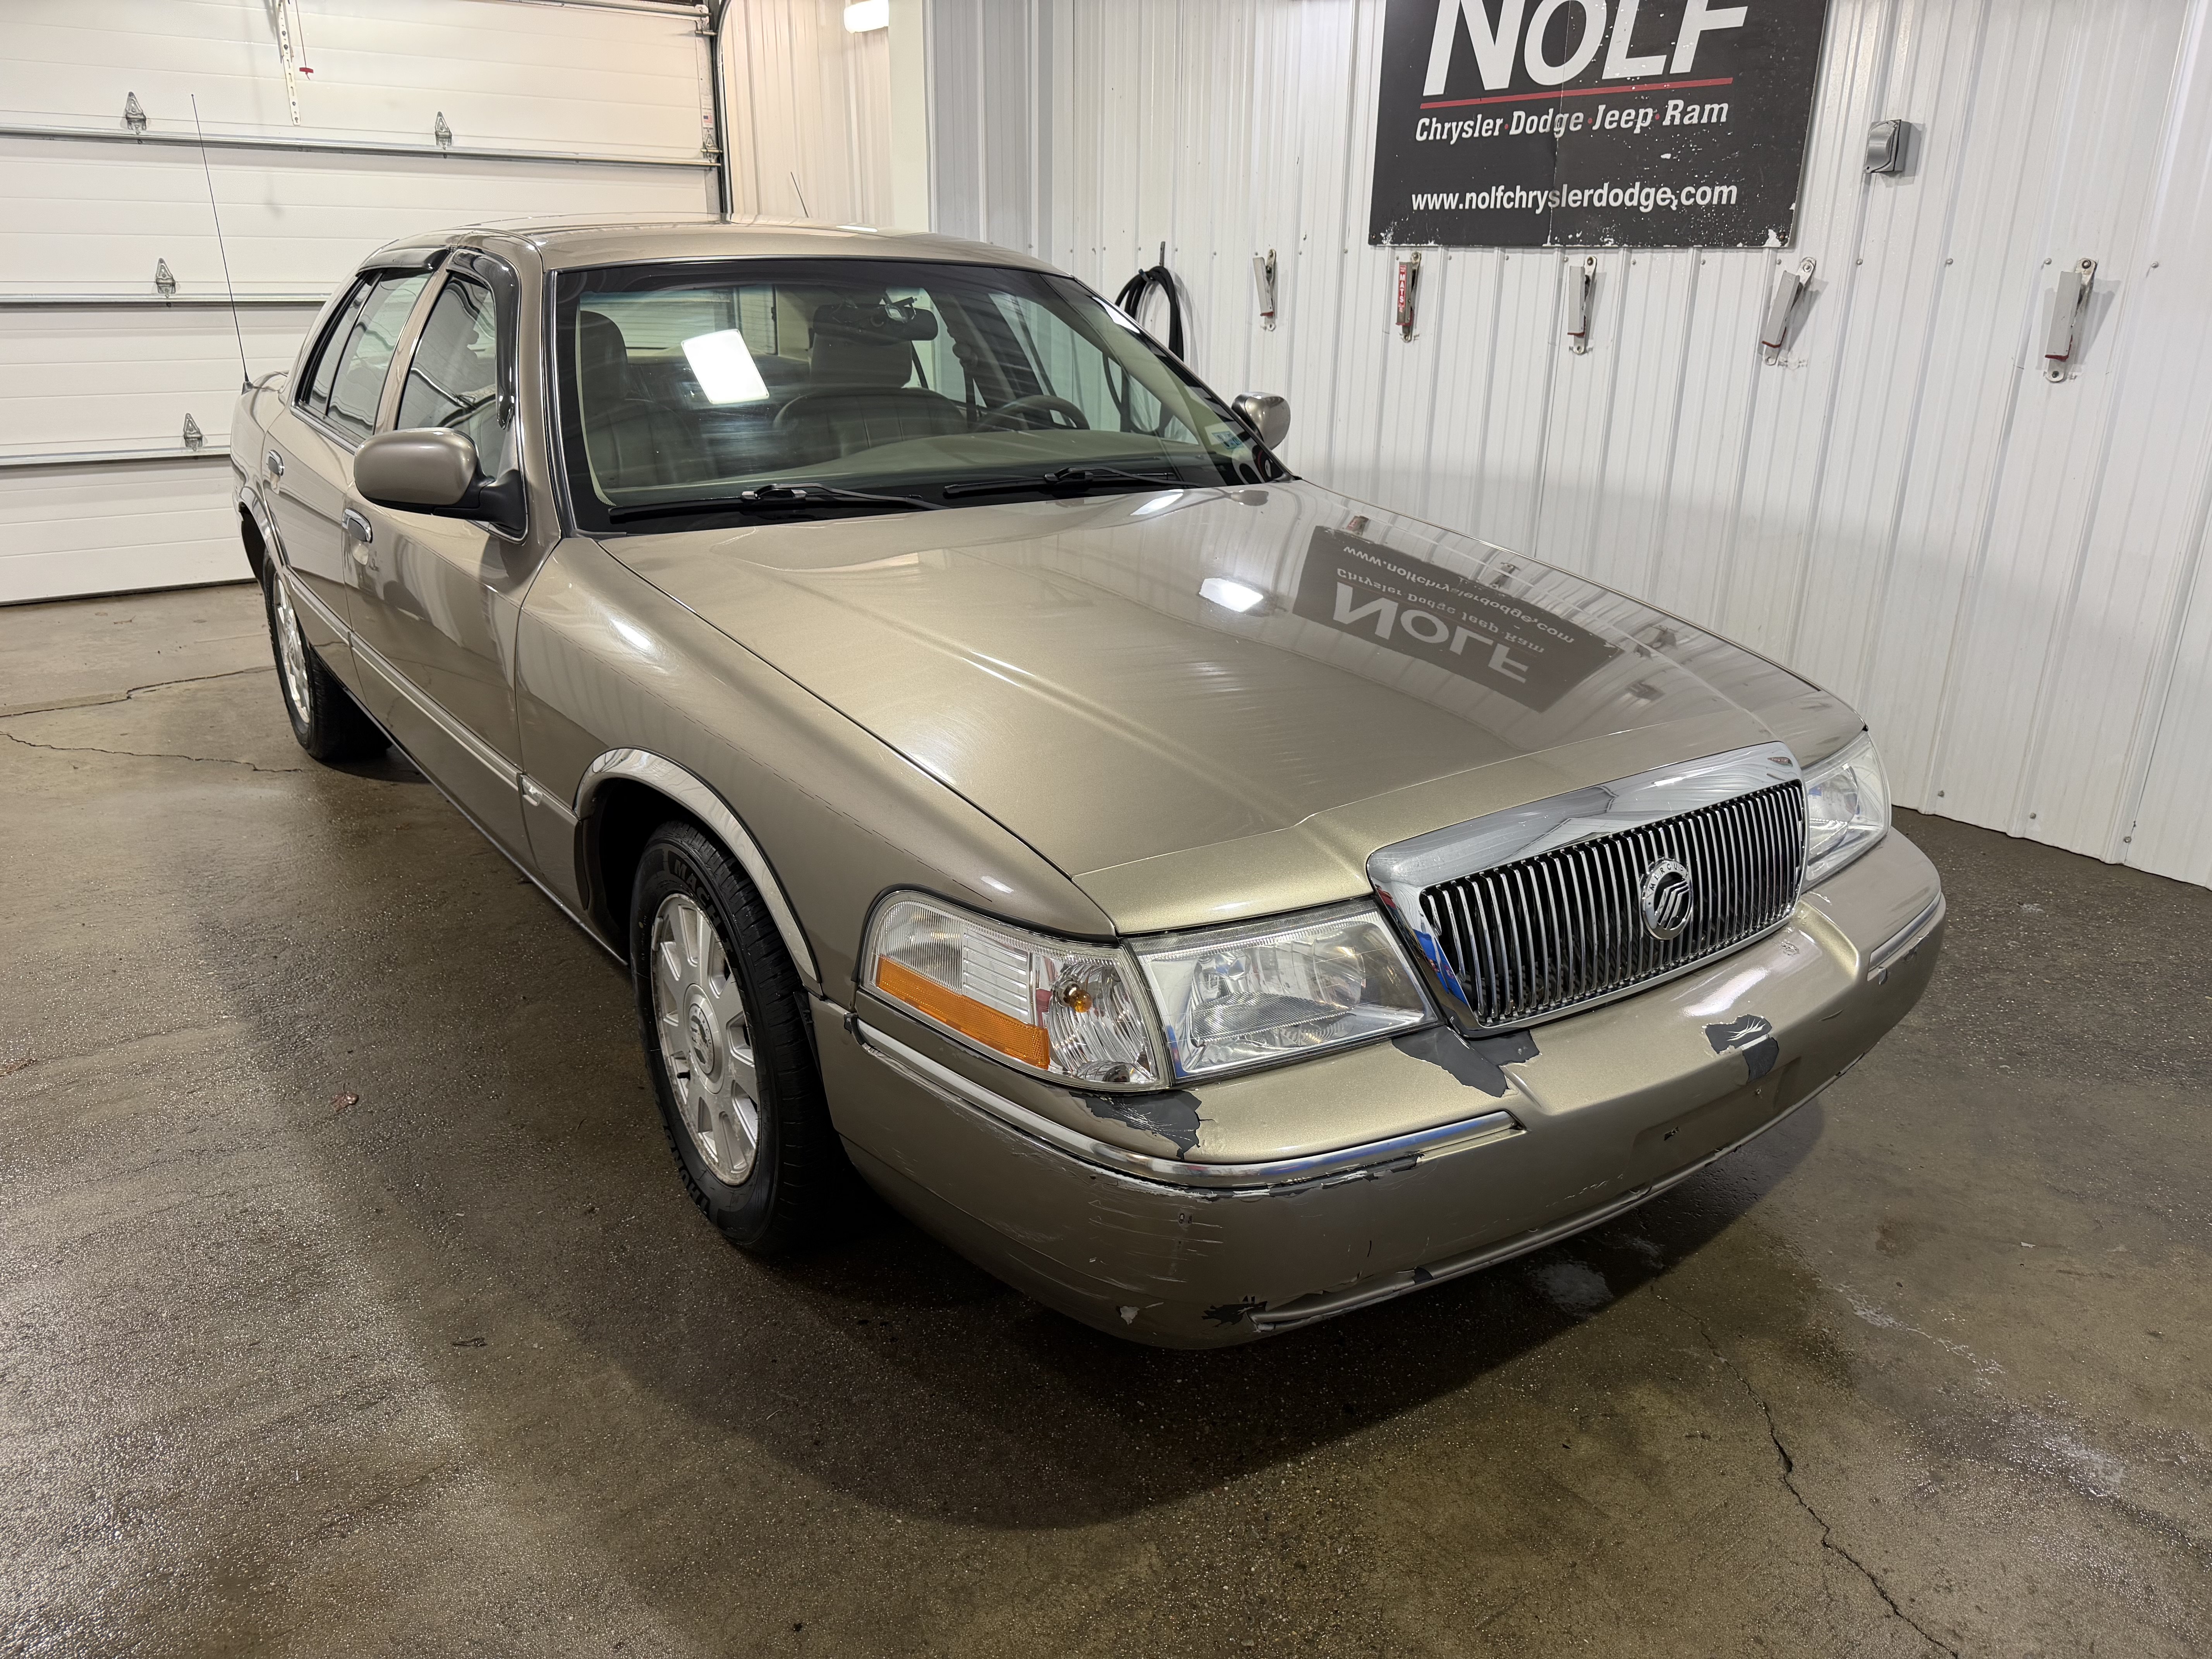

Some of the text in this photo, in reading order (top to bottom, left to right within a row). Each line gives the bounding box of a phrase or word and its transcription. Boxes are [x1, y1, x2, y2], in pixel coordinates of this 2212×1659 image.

[1423, 0, 1748, 96] NOLF
[1416, 100, 1729, 145] Chrysler Dodge Jeep Ram
[1412, 182, 1737, 214] www.nolfchryslerdodge.com
[674, 859, 722, 929] MACH
[1649, 863, 1688, 891] MERCURY
